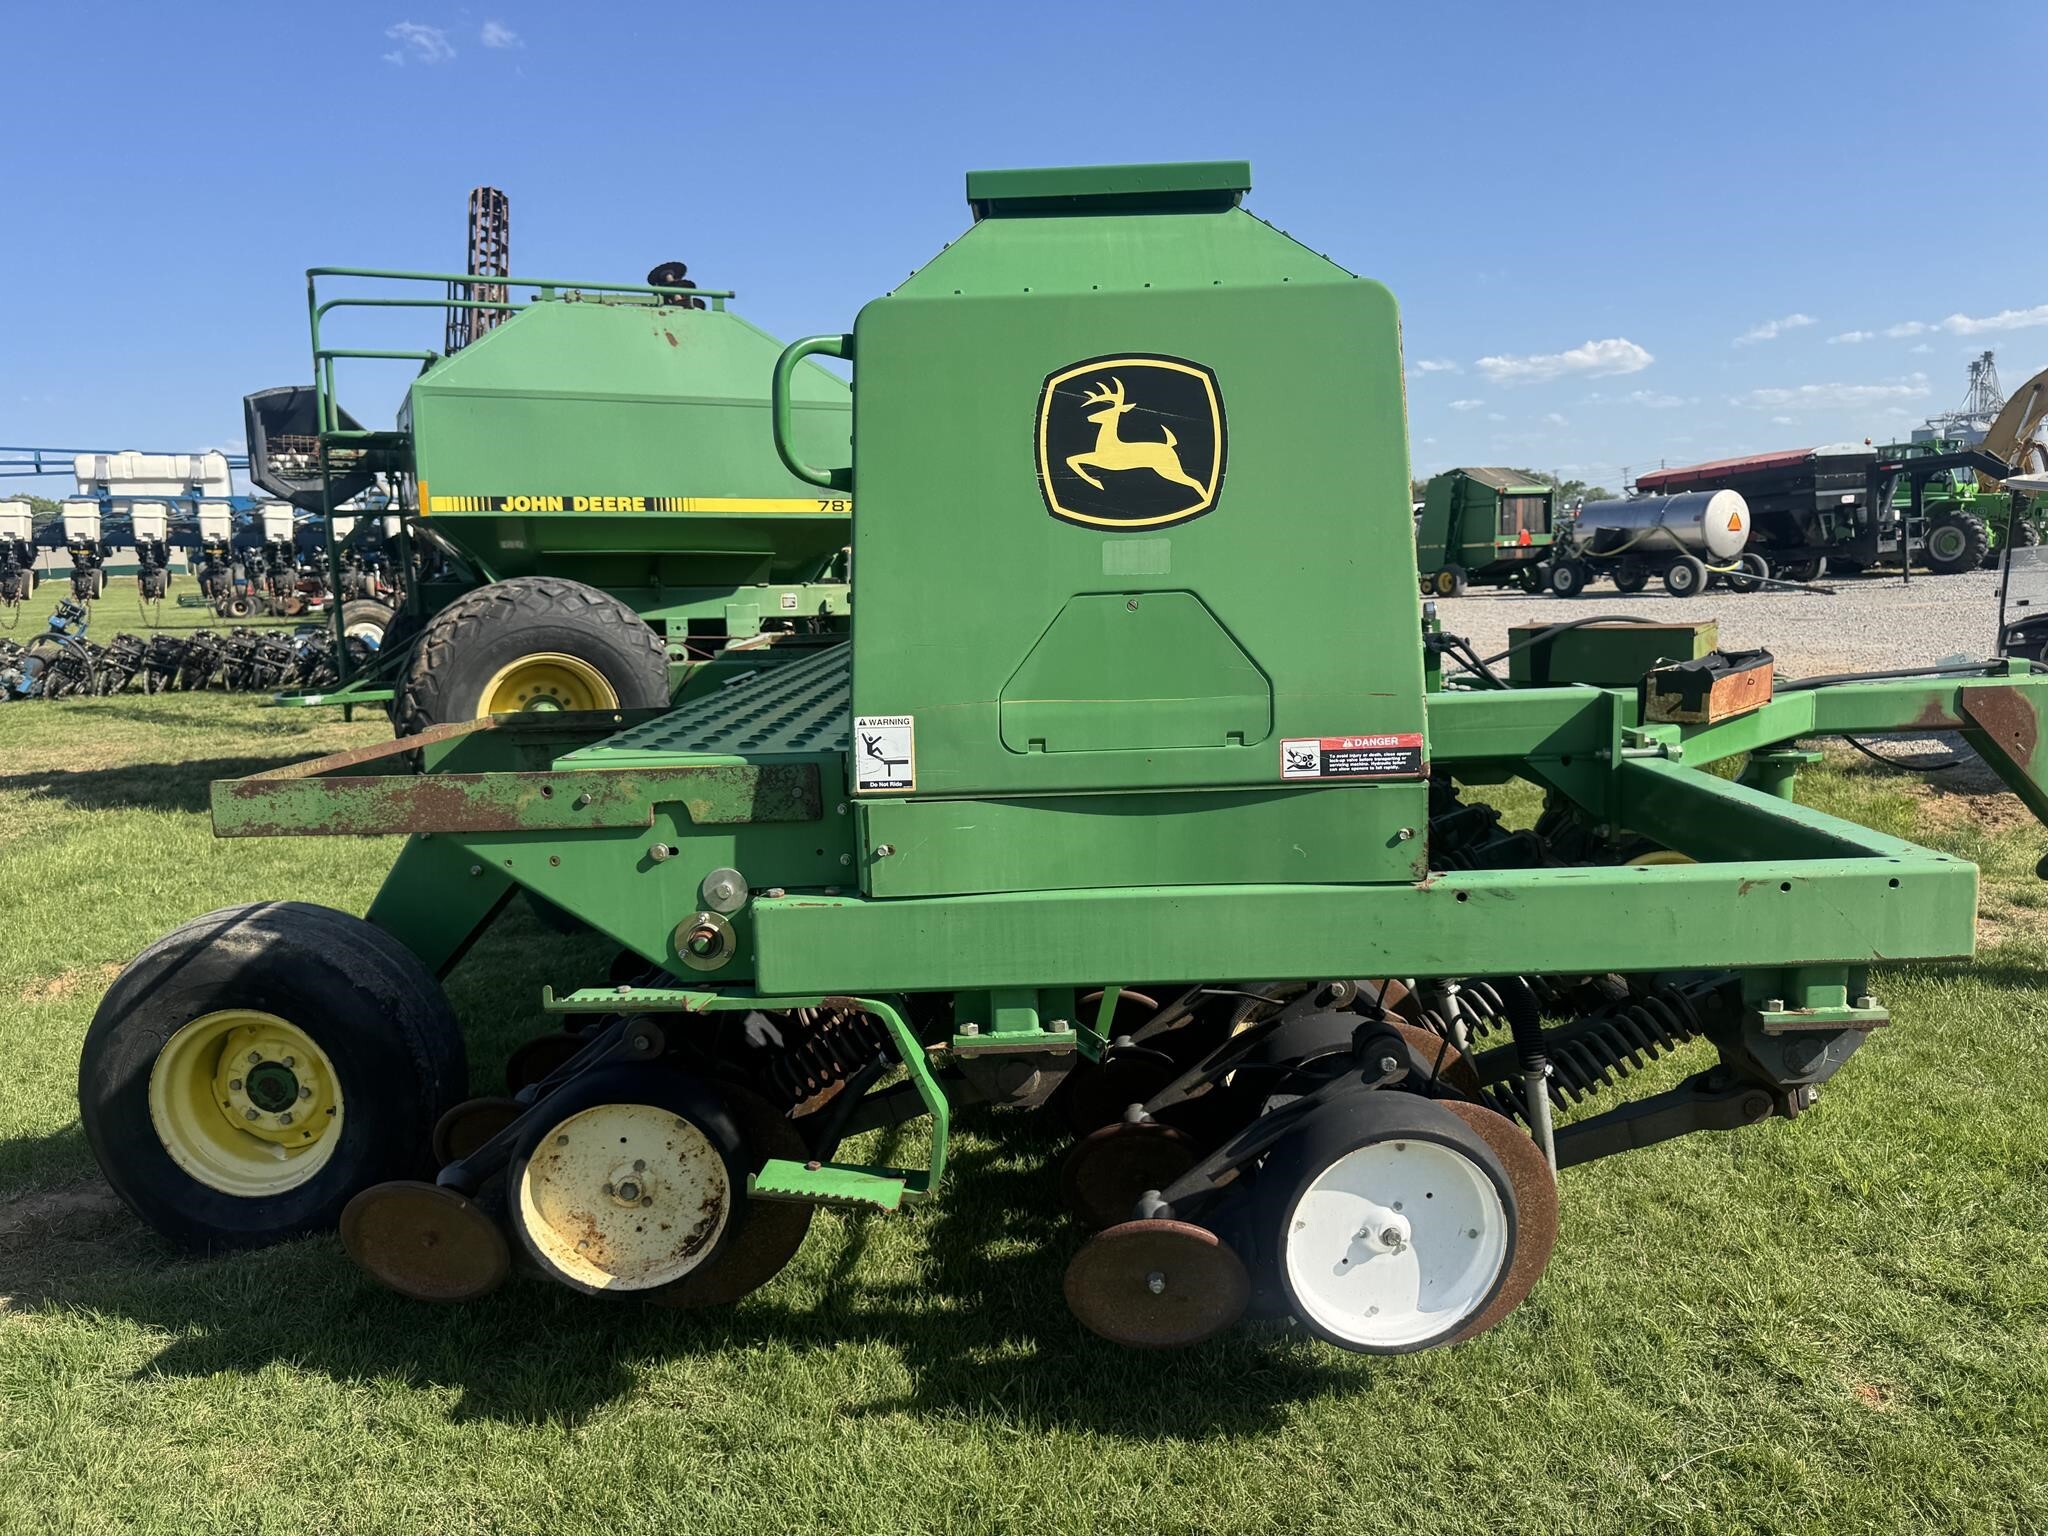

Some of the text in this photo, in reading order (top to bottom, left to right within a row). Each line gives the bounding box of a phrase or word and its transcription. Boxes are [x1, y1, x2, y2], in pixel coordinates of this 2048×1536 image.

[500, 496, 646, 512] JOHN DEERE
[868, 718, 910, 726] WARNING
[1354, 736, 1399, 747] DANGER
